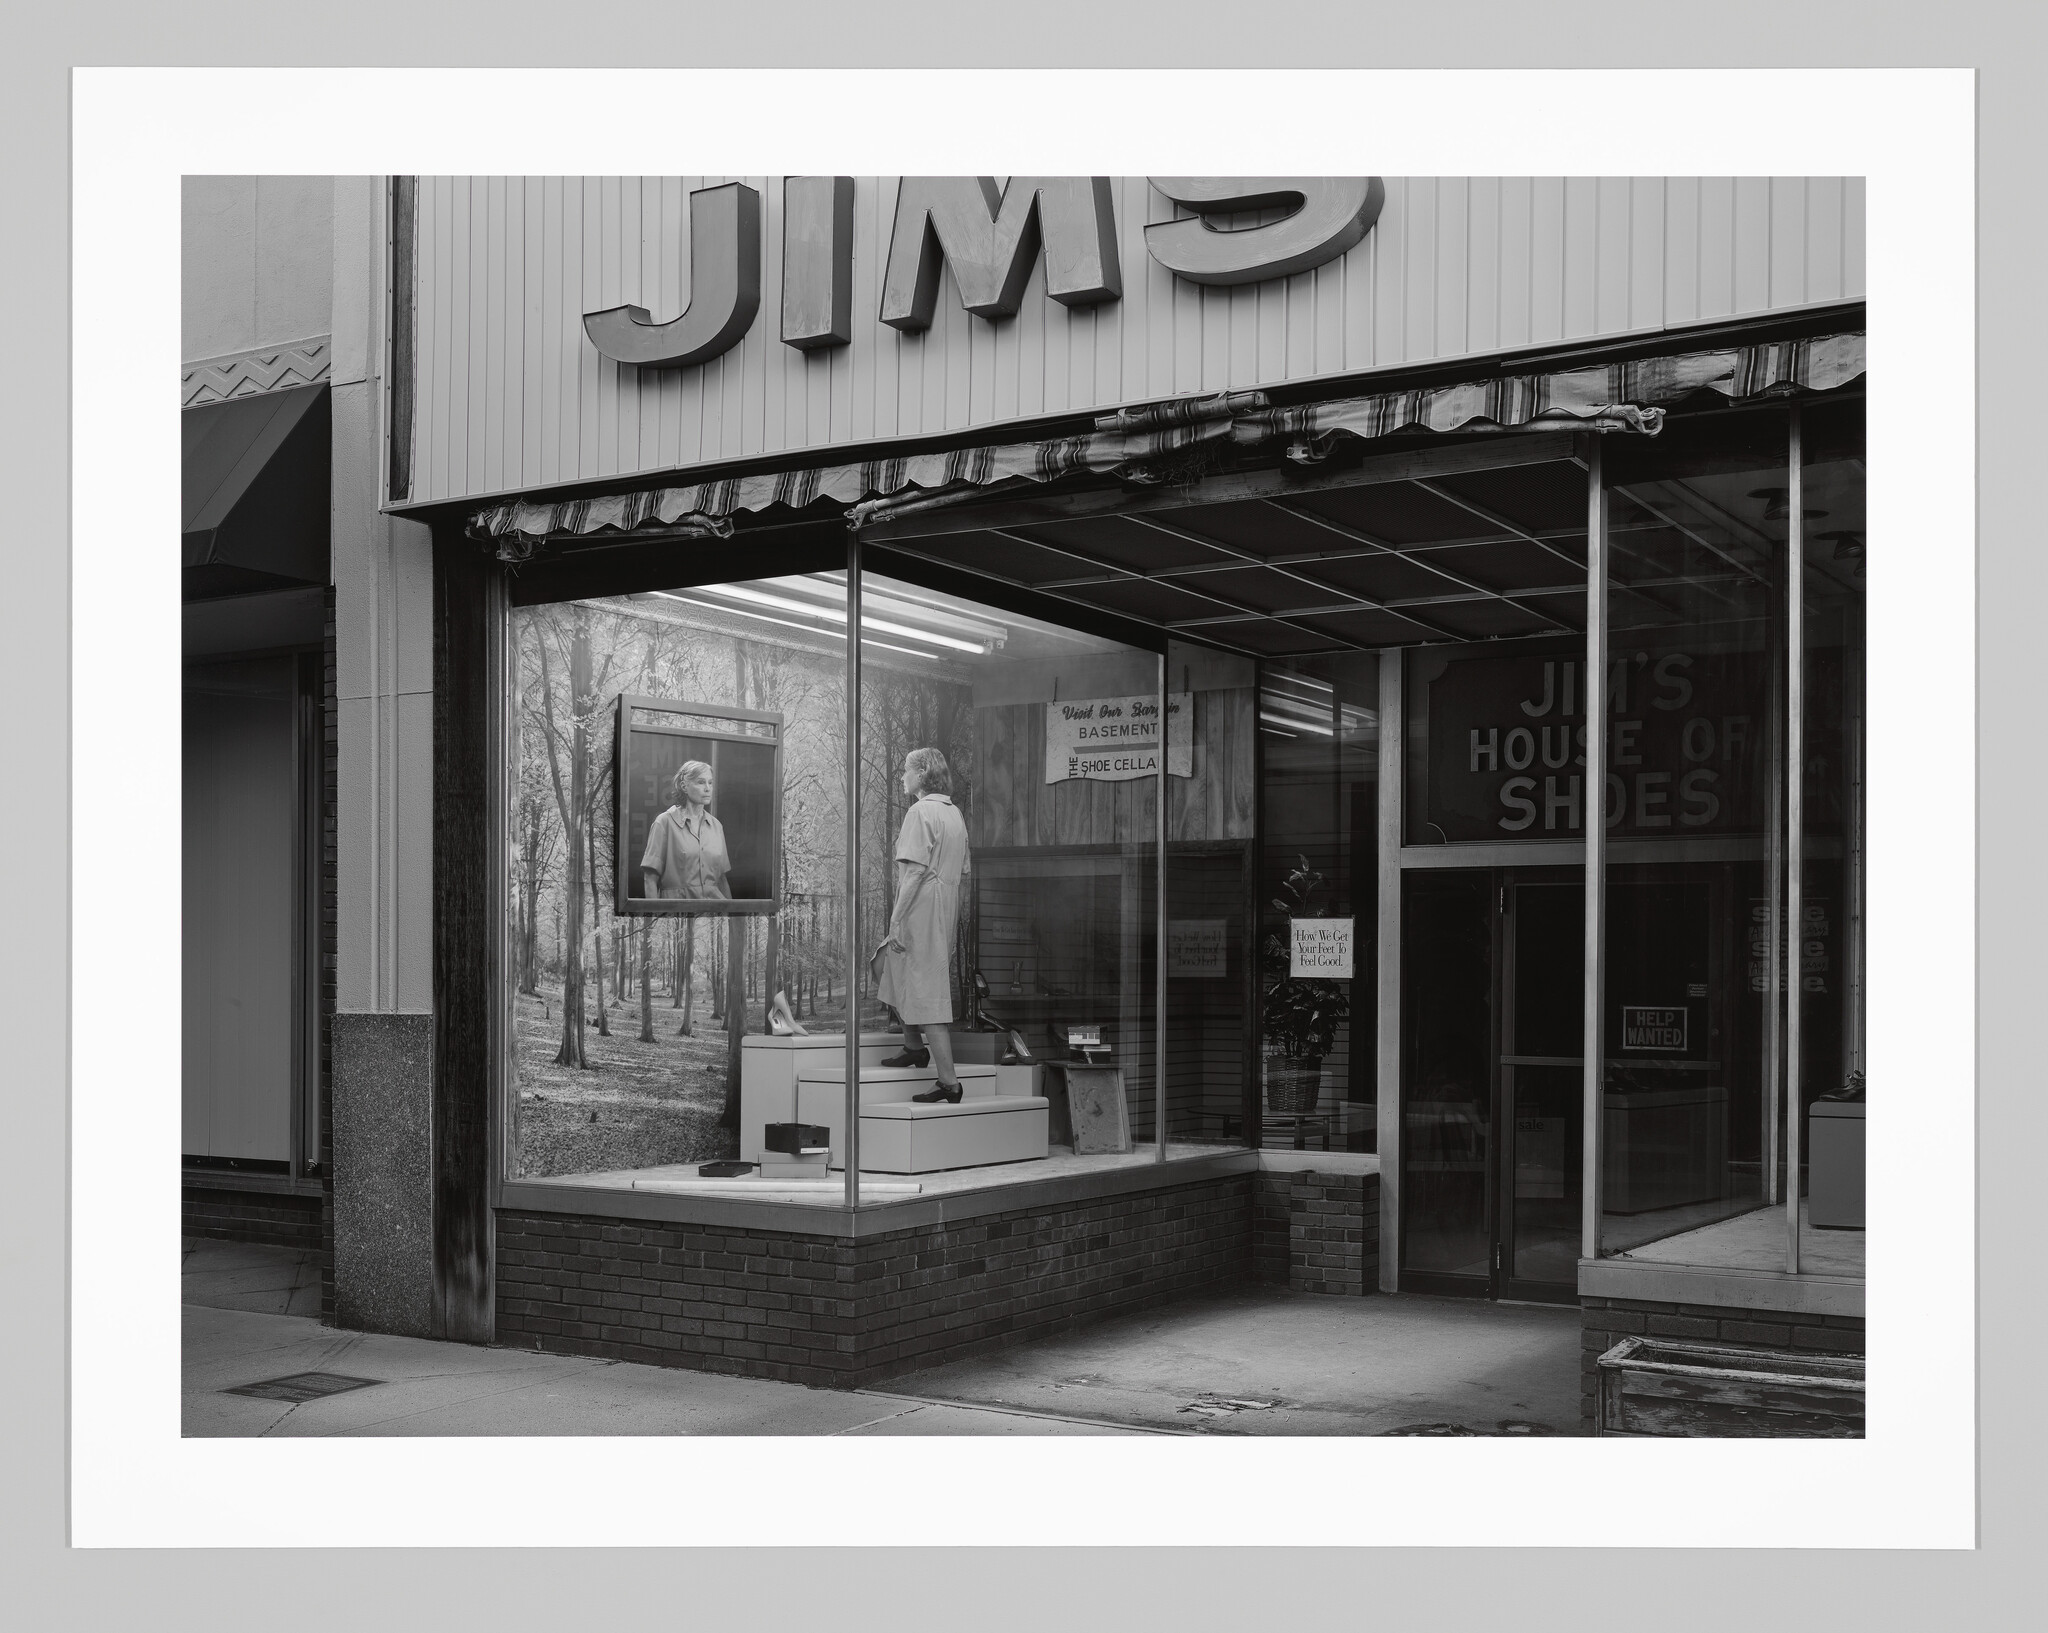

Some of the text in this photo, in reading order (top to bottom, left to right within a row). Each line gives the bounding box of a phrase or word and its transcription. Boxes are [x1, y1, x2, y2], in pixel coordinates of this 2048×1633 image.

[1062, 704, 1094, 720] Visit
[1099, 704, 1123, 719] Our
[1079, 722, 1158, 739] BASEMENT
[1681, 715, 1752, 762] OF
[1069, 756, 1078, 778] THE
[1081, 759, 1111, 775] SHOE
[1296, 929, 1348, 941] How We Get
[1297, 941, 1347, 954] Your Feet To
[1300, 954, 1344, 967] Feel Good.
[1636, 1011, 1675, 1026] HELP
[1628, 1027, 1682, 1046] WANTED
[1519, 1119, 1544, 1130] sale
